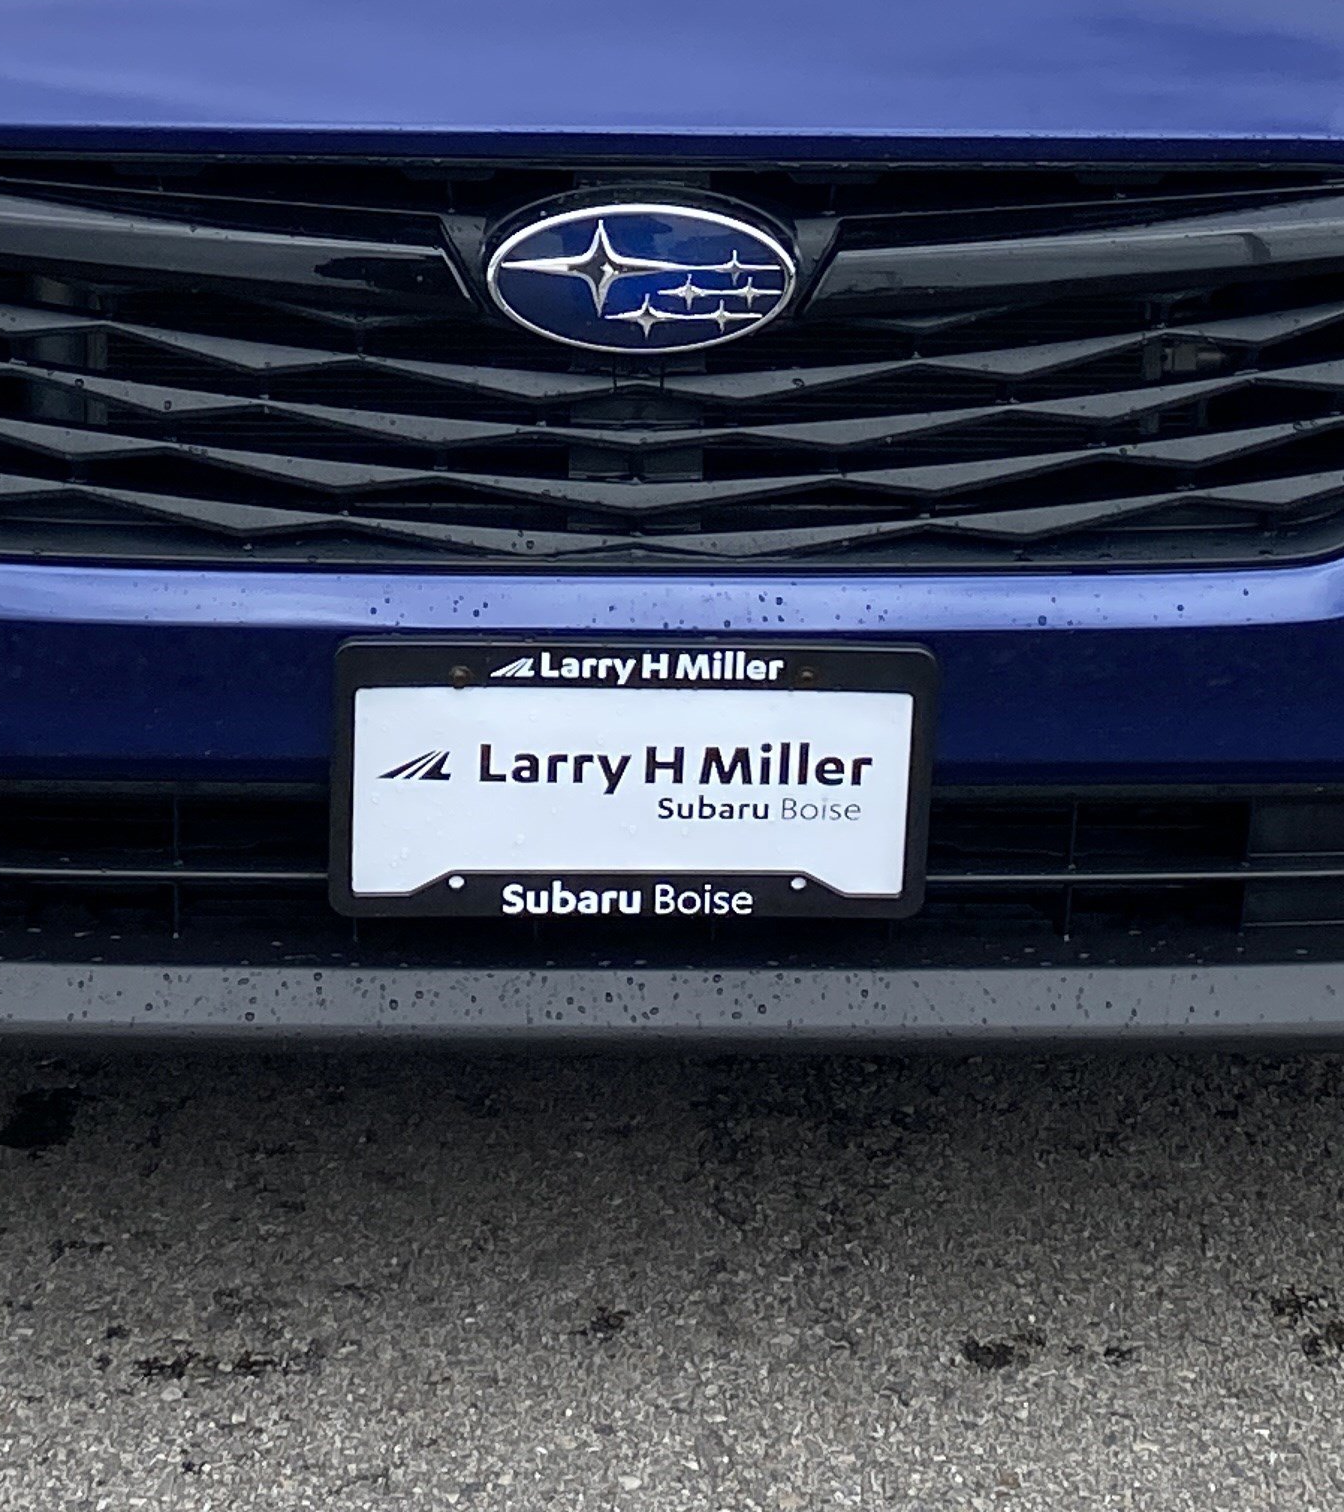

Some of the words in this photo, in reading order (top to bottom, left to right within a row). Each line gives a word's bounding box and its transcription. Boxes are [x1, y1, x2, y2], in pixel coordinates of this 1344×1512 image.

[540, 651, 636, 684] Larry
[642, 653, 668, 679] H
[675, 652, 784, 681] Miller
[478, 743, 631, 794] Larry
[645, 746, 684, 784] H
[698, 742, 873, 787] Miller
[657, 796, 770, 821] Subaru
[781, 798, 862, 822] Boise
[502, 882, 642, 915] Subaru
[653, 884, 754, 915] Boise
